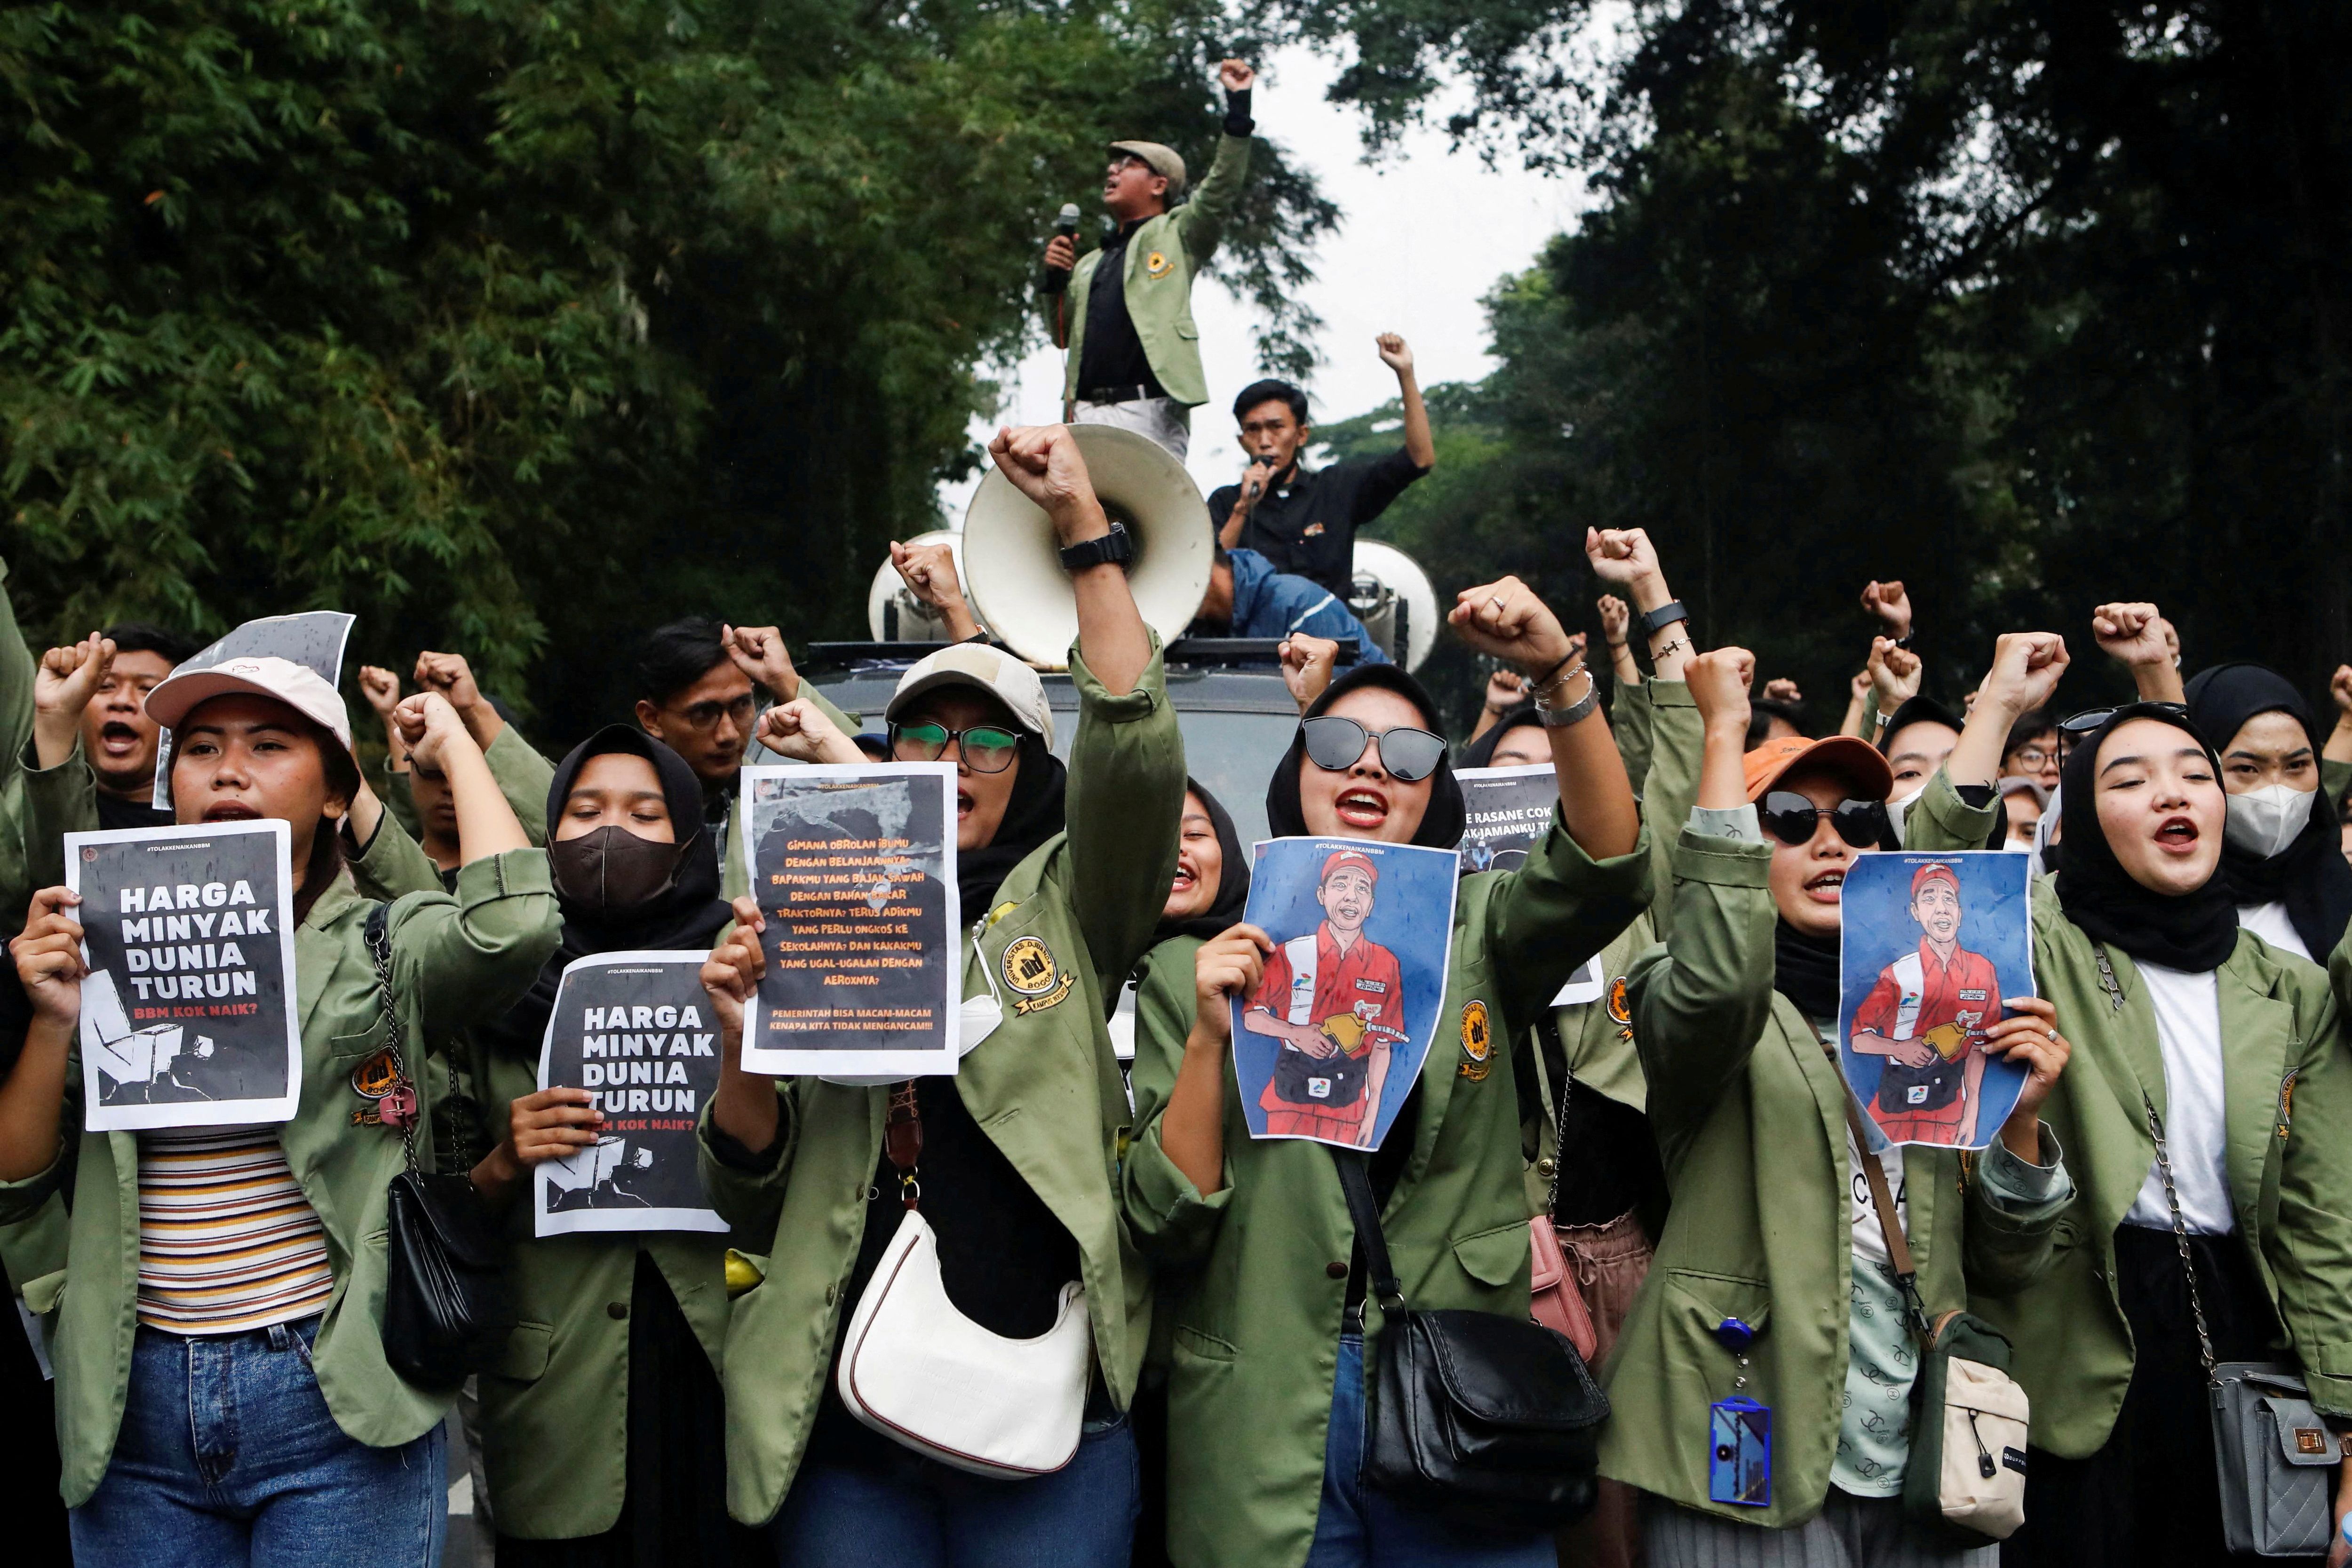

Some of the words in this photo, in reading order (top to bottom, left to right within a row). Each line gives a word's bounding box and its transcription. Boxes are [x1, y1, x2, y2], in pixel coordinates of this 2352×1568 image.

[1475, 809, 1524, 823] RASANE
[1526, 807, 1552, 818] COK
[1479, 822, 1536, 840] JAMANKU
[147, 843, 210, 852] #TOLAKKENAIKANBBM
[830, 839, 876, 849] OBROLAN
[1315, 844, 1384, 855] #TOLAKKENAIKANBBM
[785, 857, 827, 867] DENGAN
[771, 875, 820, 884] BAPAKMU
[824, 875, 850, 883] YANG
[852, 873, 885, 883] BAJAK
[888, 873, 924, 883] SAWAH
[120, 880, 255, 913] HARGA
[790, 891, 831, 901] DENGAN
[833, 891, 868, 900] BAHAN
[870, 889, 906, 899] BAKAR
[777, 907, 846, 917] TRAKTORNYA?
[849, 907, 880, 917] TERUS
[121, 909, 271, 944] MINYAK
[793, 925, 819, 934] YANG
[821, 924, 853, 934] PERLU
[854, 924, 893, 934] ONGKOS
[895, 923, 908, 934] KE
[780, 941, 846, 951] SEKOLAHNYA?
[849, 941, 871, 950] DAN
[873, 941, 922, 950] KAKAKMU
[126, 942, 246, 972] DUNIA
[809, 959, 880, 968] UGAL-UGALAN
[881, 957, 922, 967] DENGAN
[1007, 943, 1025, 984] UNIVERSITAS
[1027, 941, 1051, 965] DJUANDA
[130, 971, 256, 1000] TURUN
[824, 974, 878, 985] AEROXNYA?
[1028, 972, 1052, 988] BOGOR
[134, 1007, 169, 1019] BBM
[174, 1006, 205, 1017] KOK
[209, 1003, 257, 1016] NAIK?
[584, 1005, 702, 1031] HARGA
[583, 1034, 714, 1058] MINYAK
[583, 1061, 688, 1086] DUNIA
[589, 1089, 695, 1113] TURUN
[618, 1120, 647, 1130] KOK
[652, 1120, 694, 1130] NAIK?
